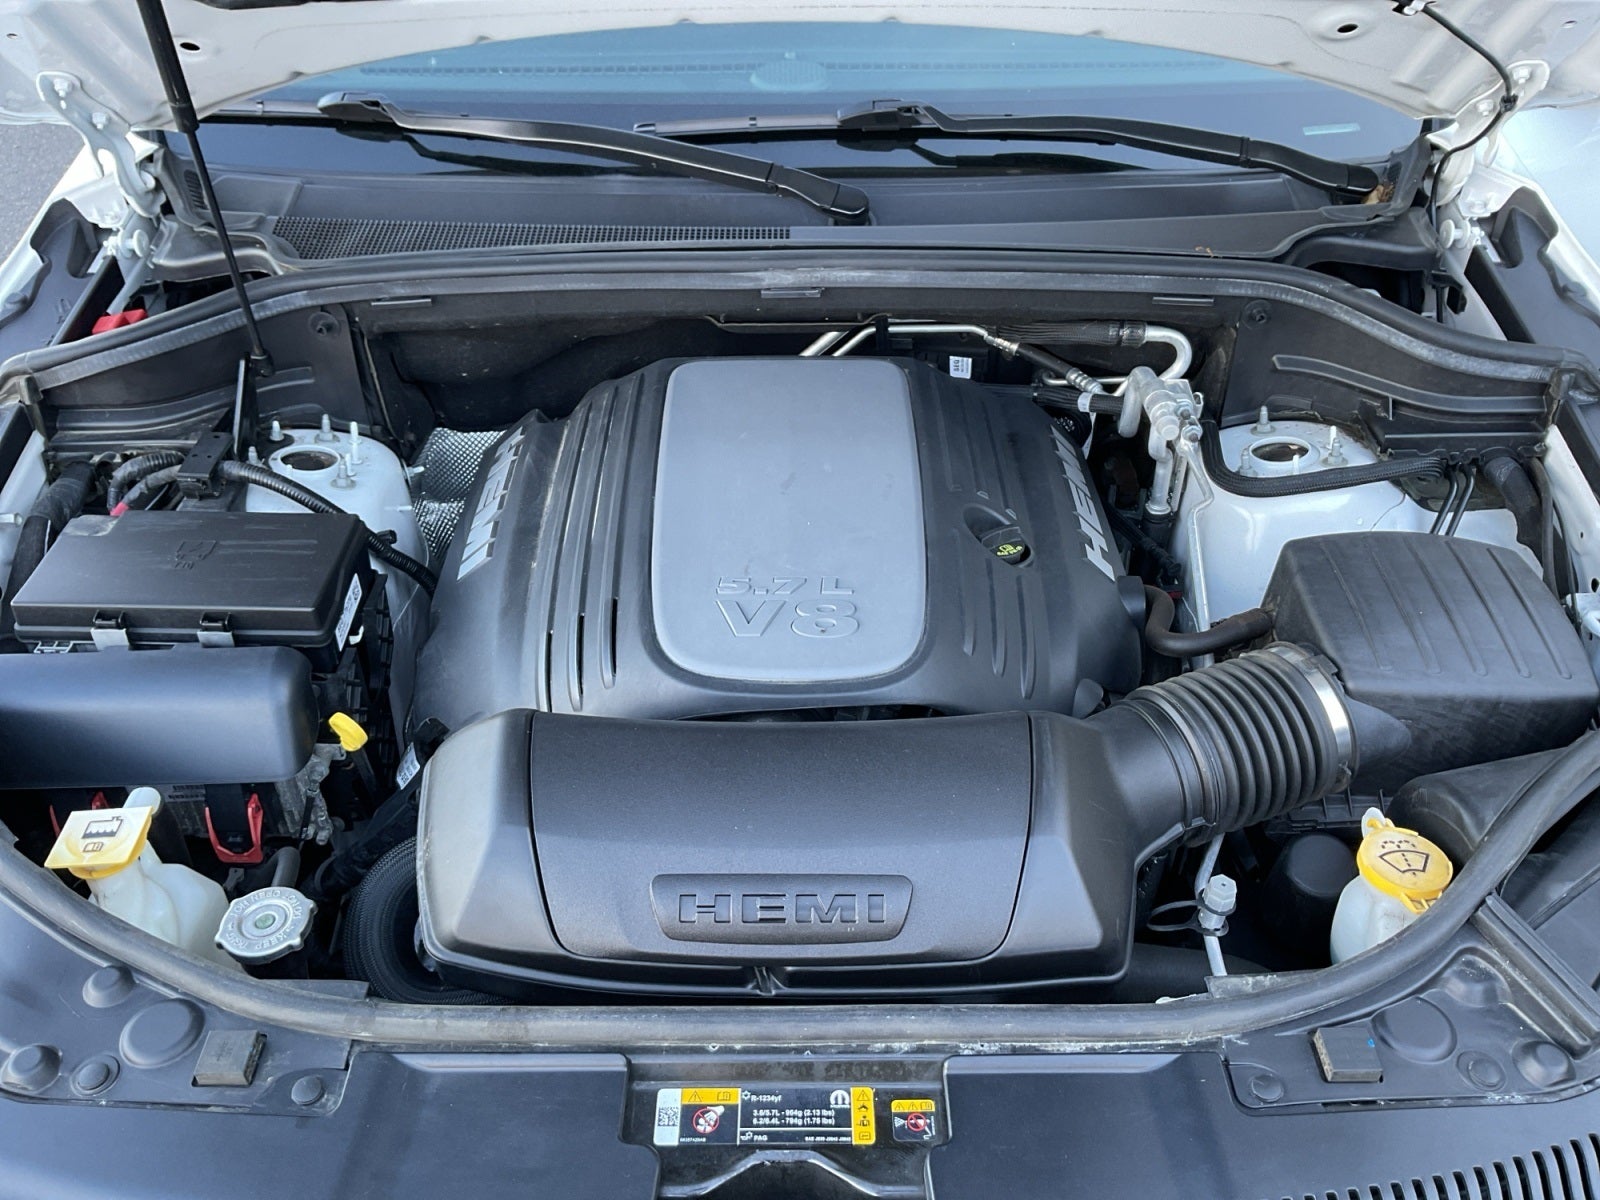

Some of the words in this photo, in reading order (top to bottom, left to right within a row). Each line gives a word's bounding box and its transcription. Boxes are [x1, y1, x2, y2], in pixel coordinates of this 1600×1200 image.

[457, 426, 524, 581] HEMI
[1049, 424, 1116, 581] HEMI
[715, 598, 861, 638] V8
[250, 889, 281, 903] OPEN
[679, 894, 885, 924] HEMI
[255, 930, 288, 950] KEEP
[750, 1095, 782, 1103] R-1234yf
[803, 1109, 821, 1117] (2.13
[821, 1109, 835, 1117] lbs)
[821, 1117, 835, 1126] lbs)
